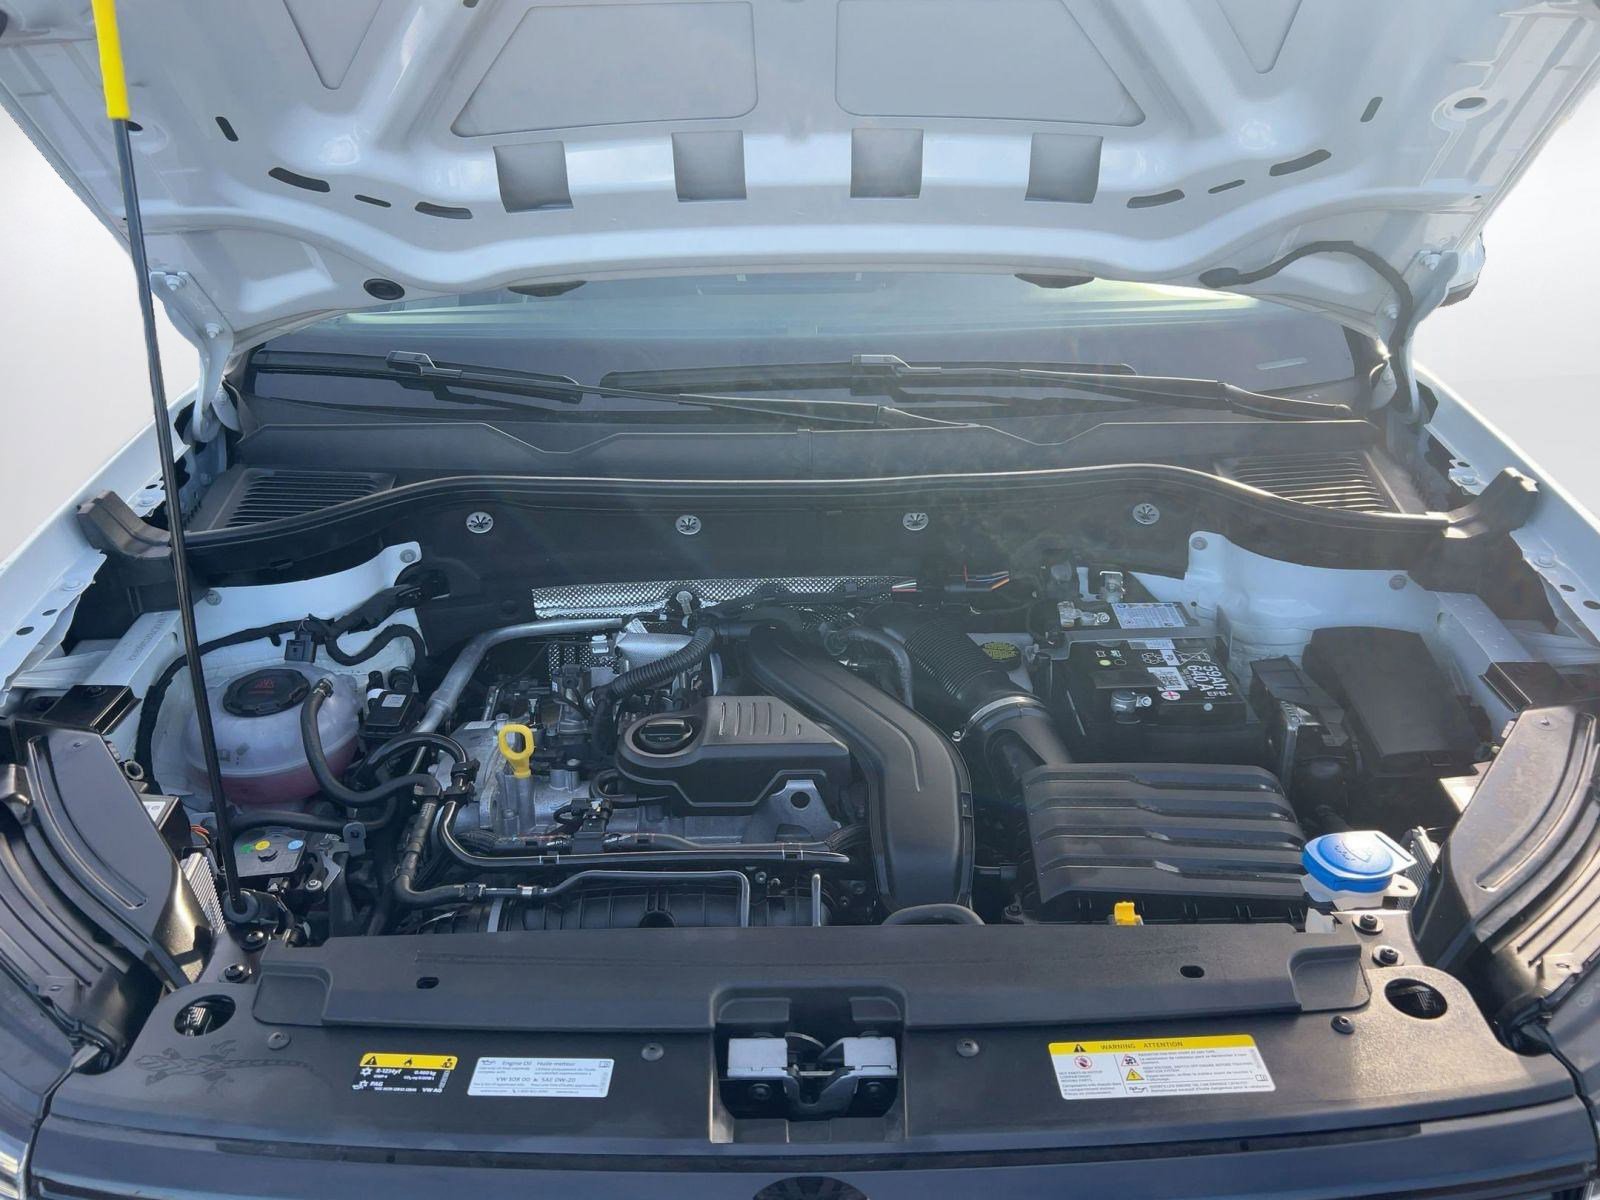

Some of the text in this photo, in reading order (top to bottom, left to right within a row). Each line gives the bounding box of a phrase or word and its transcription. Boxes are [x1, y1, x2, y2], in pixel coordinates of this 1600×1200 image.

[1187, 665, 1209, 682] 640
[1203, 665, 1229, 690] 59Ah
[1197, 683, 1214, 691] A
[1100, 1041, 1184, 1051] WARNING ATTENTION
